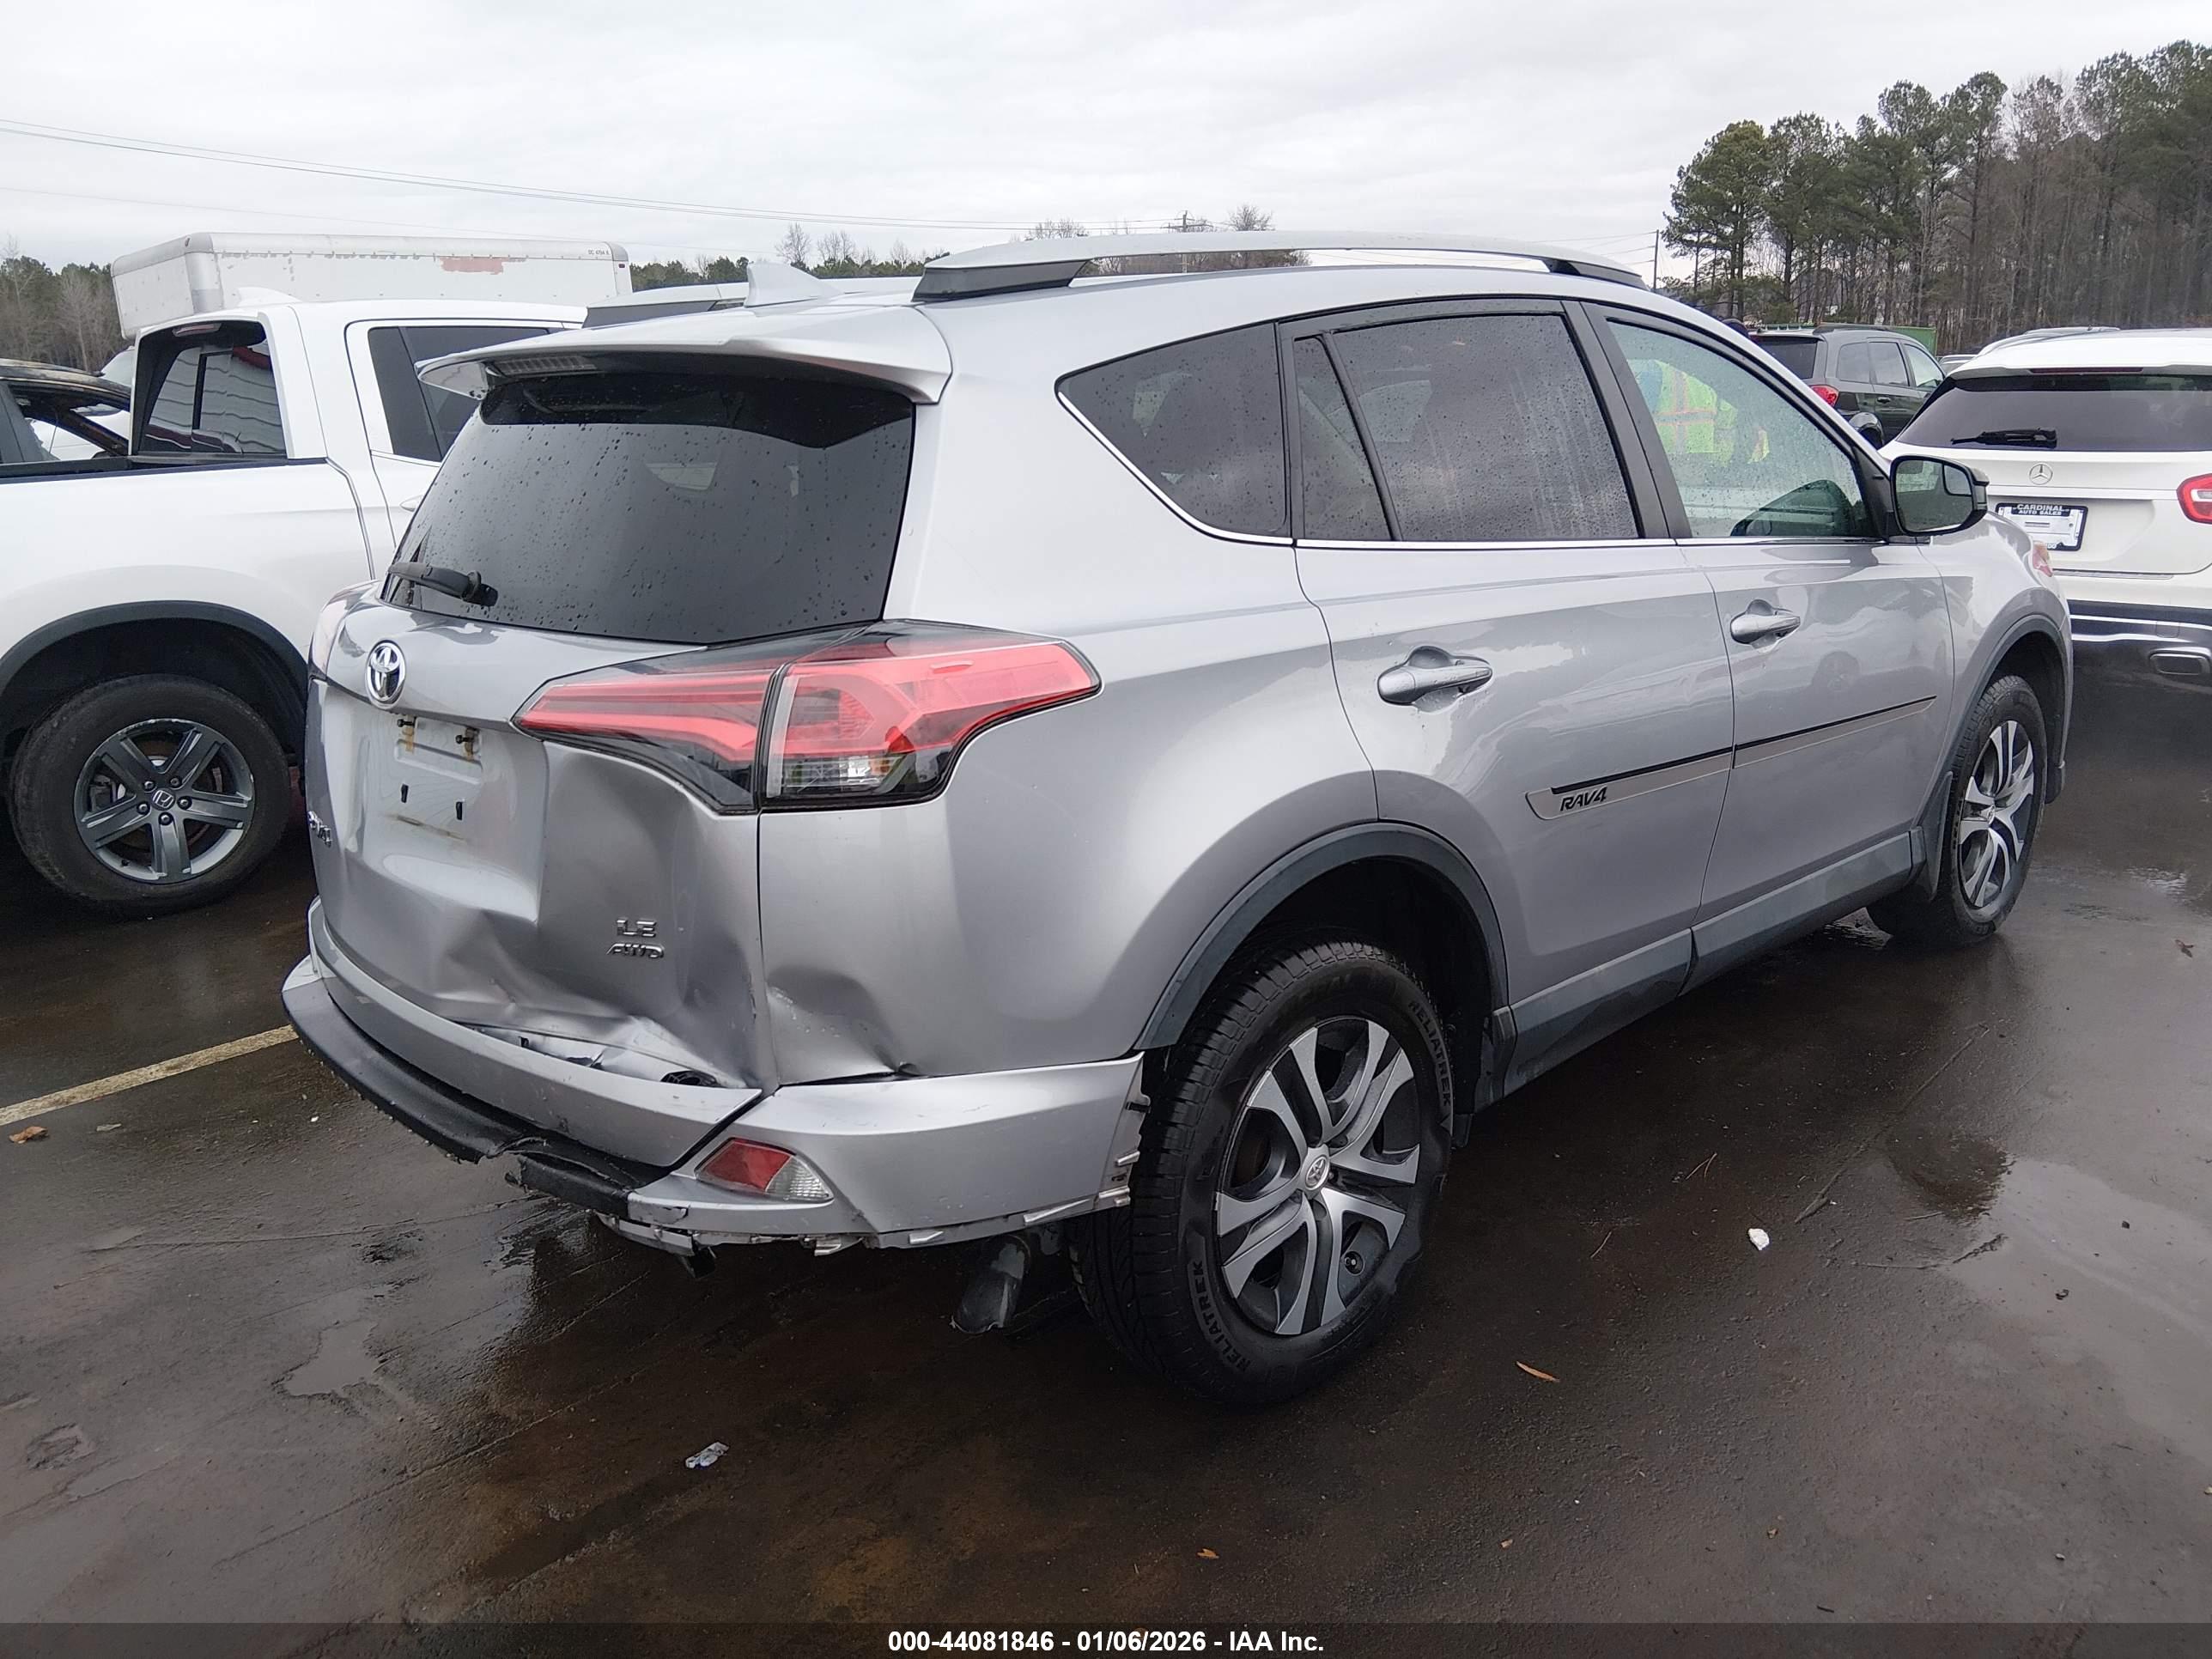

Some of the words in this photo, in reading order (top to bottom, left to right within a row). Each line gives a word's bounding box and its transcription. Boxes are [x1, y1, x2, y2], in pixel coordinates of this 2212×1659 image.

[1559, 786, 1607, 811] RAV4
[617, 917, 656, 938] LE
[605, 942, 665, 959] AWD
[1408, 1000, 1452, 1107] RELIATREK
